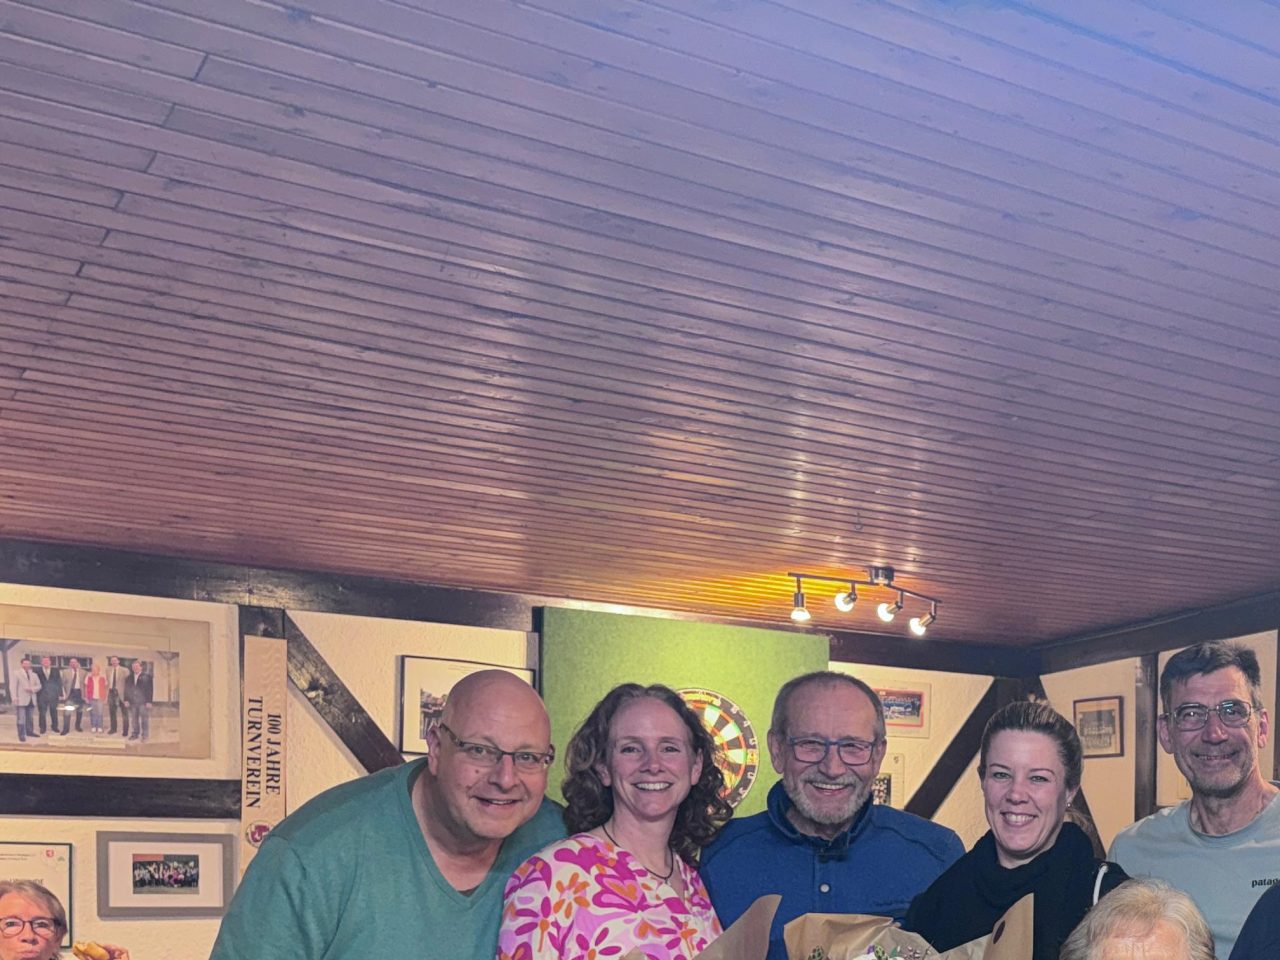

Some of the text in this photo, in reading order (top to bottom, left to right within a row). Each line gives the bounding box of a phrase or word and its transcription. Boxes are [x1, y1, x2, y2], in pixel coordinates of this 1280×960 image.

[246, 696, 263, 809] TURNVEREIN
[266, 713, 282, 795] 100 JAHRE
